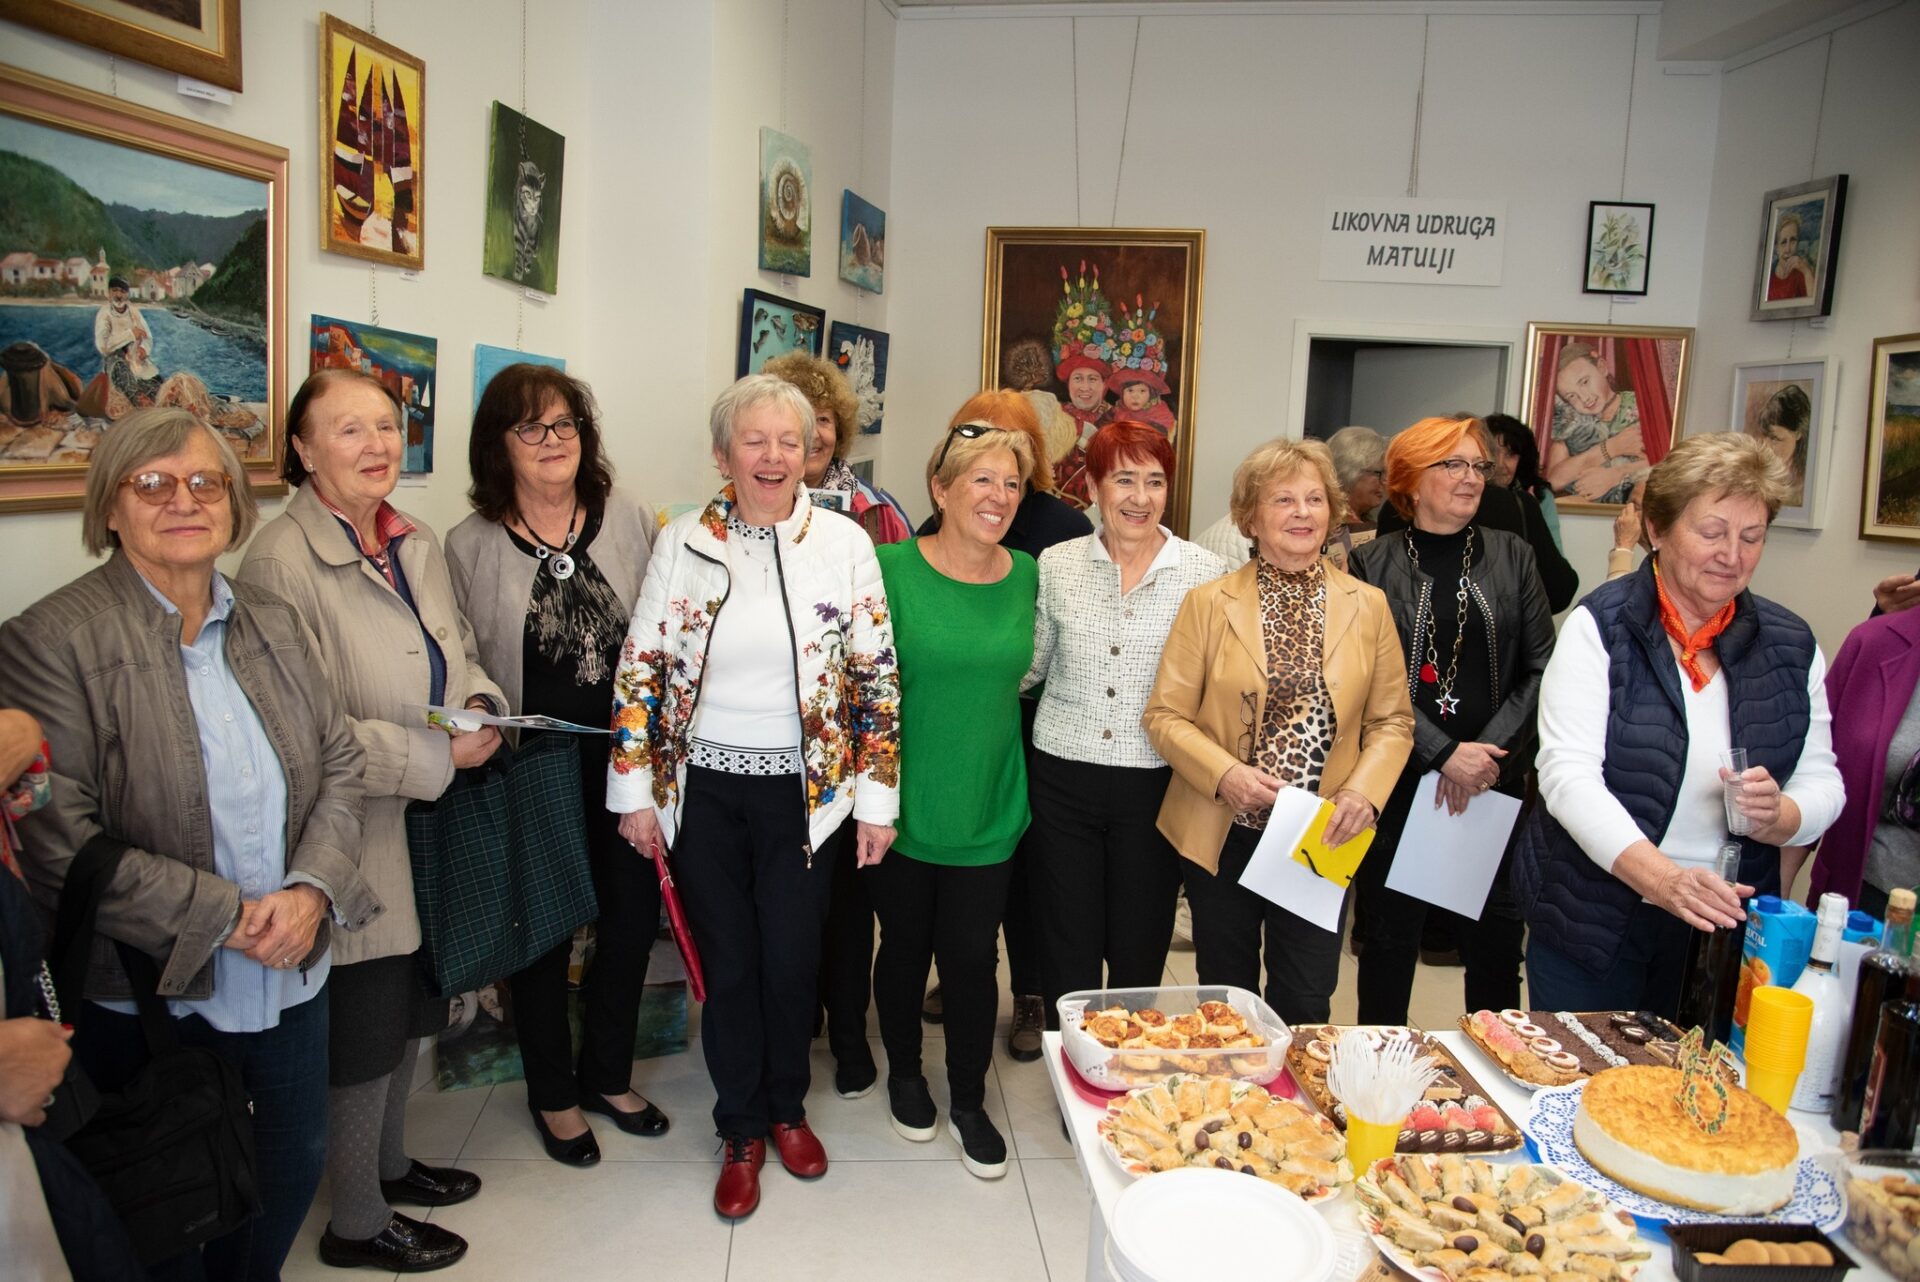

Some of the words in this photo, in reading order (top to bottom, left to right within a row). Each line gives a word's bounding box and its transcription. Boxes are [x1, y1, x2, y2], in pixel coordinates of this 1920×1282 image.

[1331, 211, 1410, 233] LIKOVNA
[1416, 214, 1496, 240] UDRUGA
[1366, 245, 1455, 274] MATULJI
